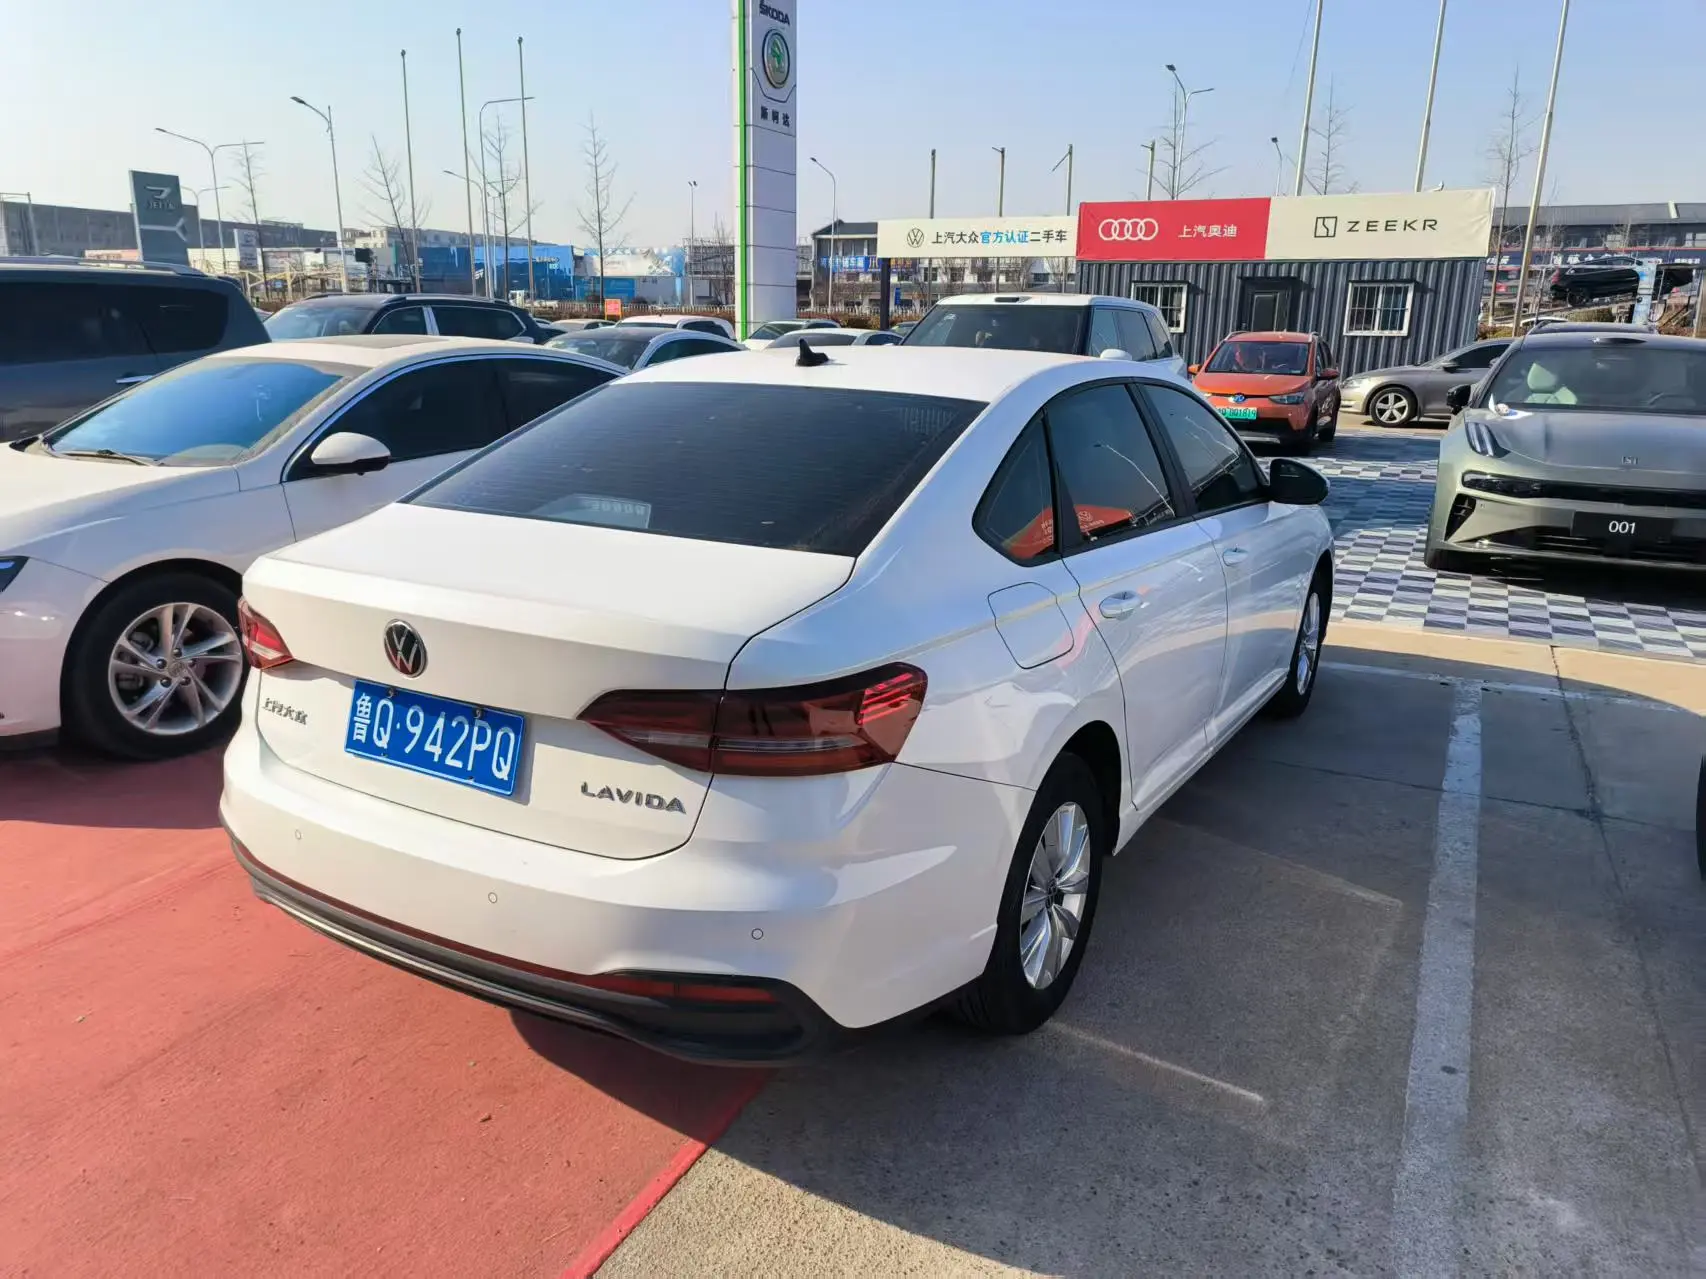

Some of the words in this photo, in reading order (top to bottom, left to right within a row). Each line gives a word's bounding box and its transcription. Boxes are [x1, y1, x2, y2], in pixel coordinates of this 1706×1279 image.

[760, 106, 790, 128] 斯柯达
[1178, 224, 1237, 238] 上汽奥迪
[1346, 219, 1438, 232] ZEEKR
[931, 229, 1068, 245] 上汽大众官方认证二手车
[1608, 520, 1636, 534] 001
[581, 781, 687, 815] LAVIDA
